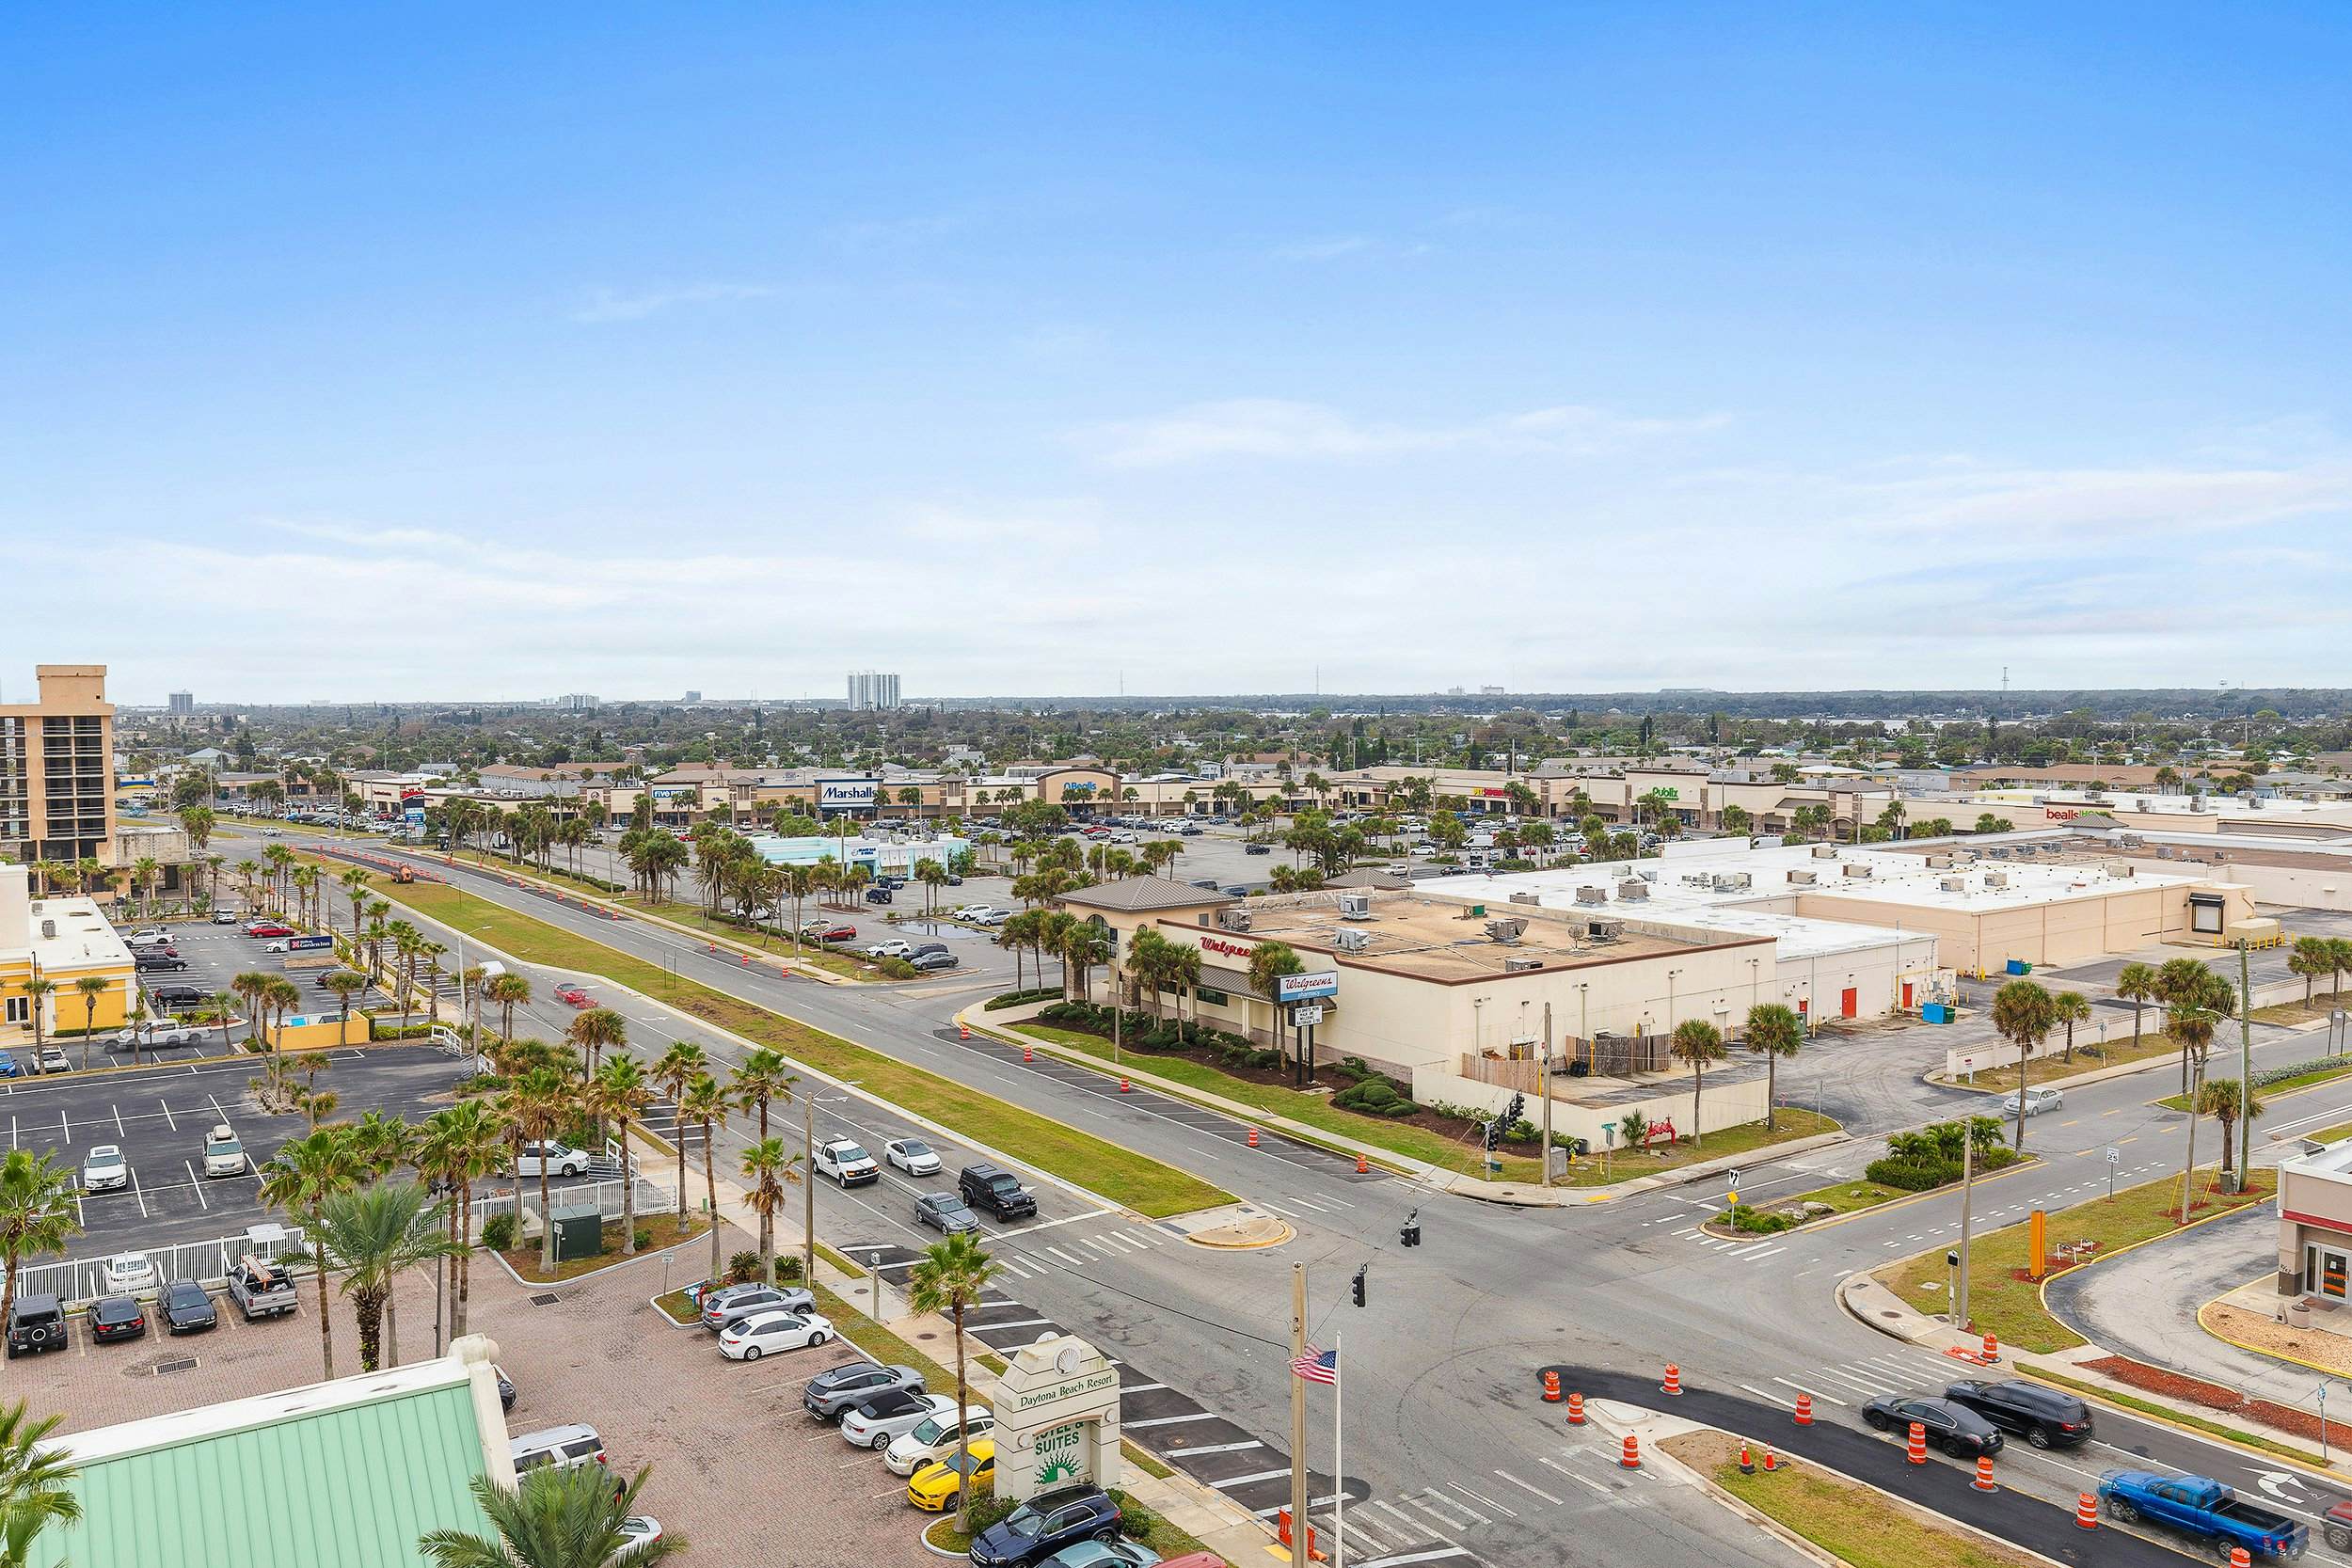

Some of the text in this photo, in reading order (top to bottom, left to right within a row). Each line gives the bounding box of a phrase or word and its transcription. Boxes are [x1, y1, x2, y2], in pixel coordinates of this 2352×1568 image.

[1652, 786, 1678, 798] Publix
[2046, 809, 2079, 820] bealls
[1200, 937, 1250, 958] Walgree
[1285, 977, 1333, 991] Walgreens
[1021, 1374, 1113, 1408] Daytona Beach Resort
[1035, 1431, 1080, 1456] SUITES
